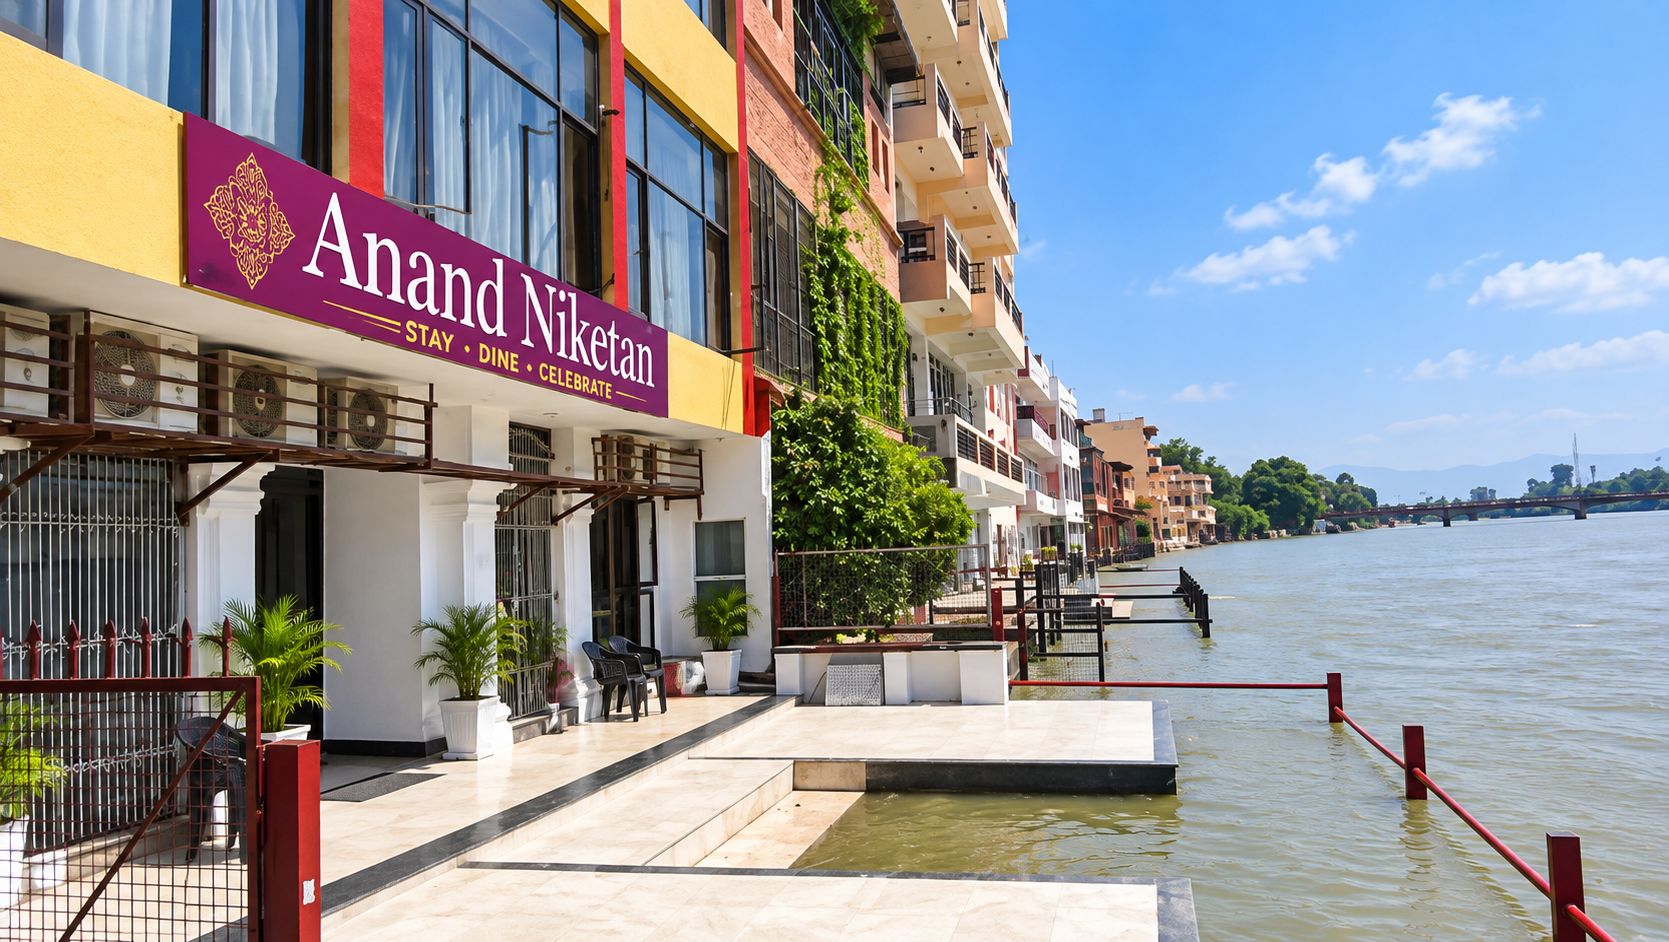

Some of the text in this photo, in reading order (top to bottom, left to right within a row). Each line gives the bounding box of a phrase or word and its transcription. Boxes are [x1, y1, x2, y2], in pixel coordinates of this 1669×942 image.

[302, 192, 655, 387] Anand Niketan
[405, 321, 612, 399] STAY DINE CELEBRATE
